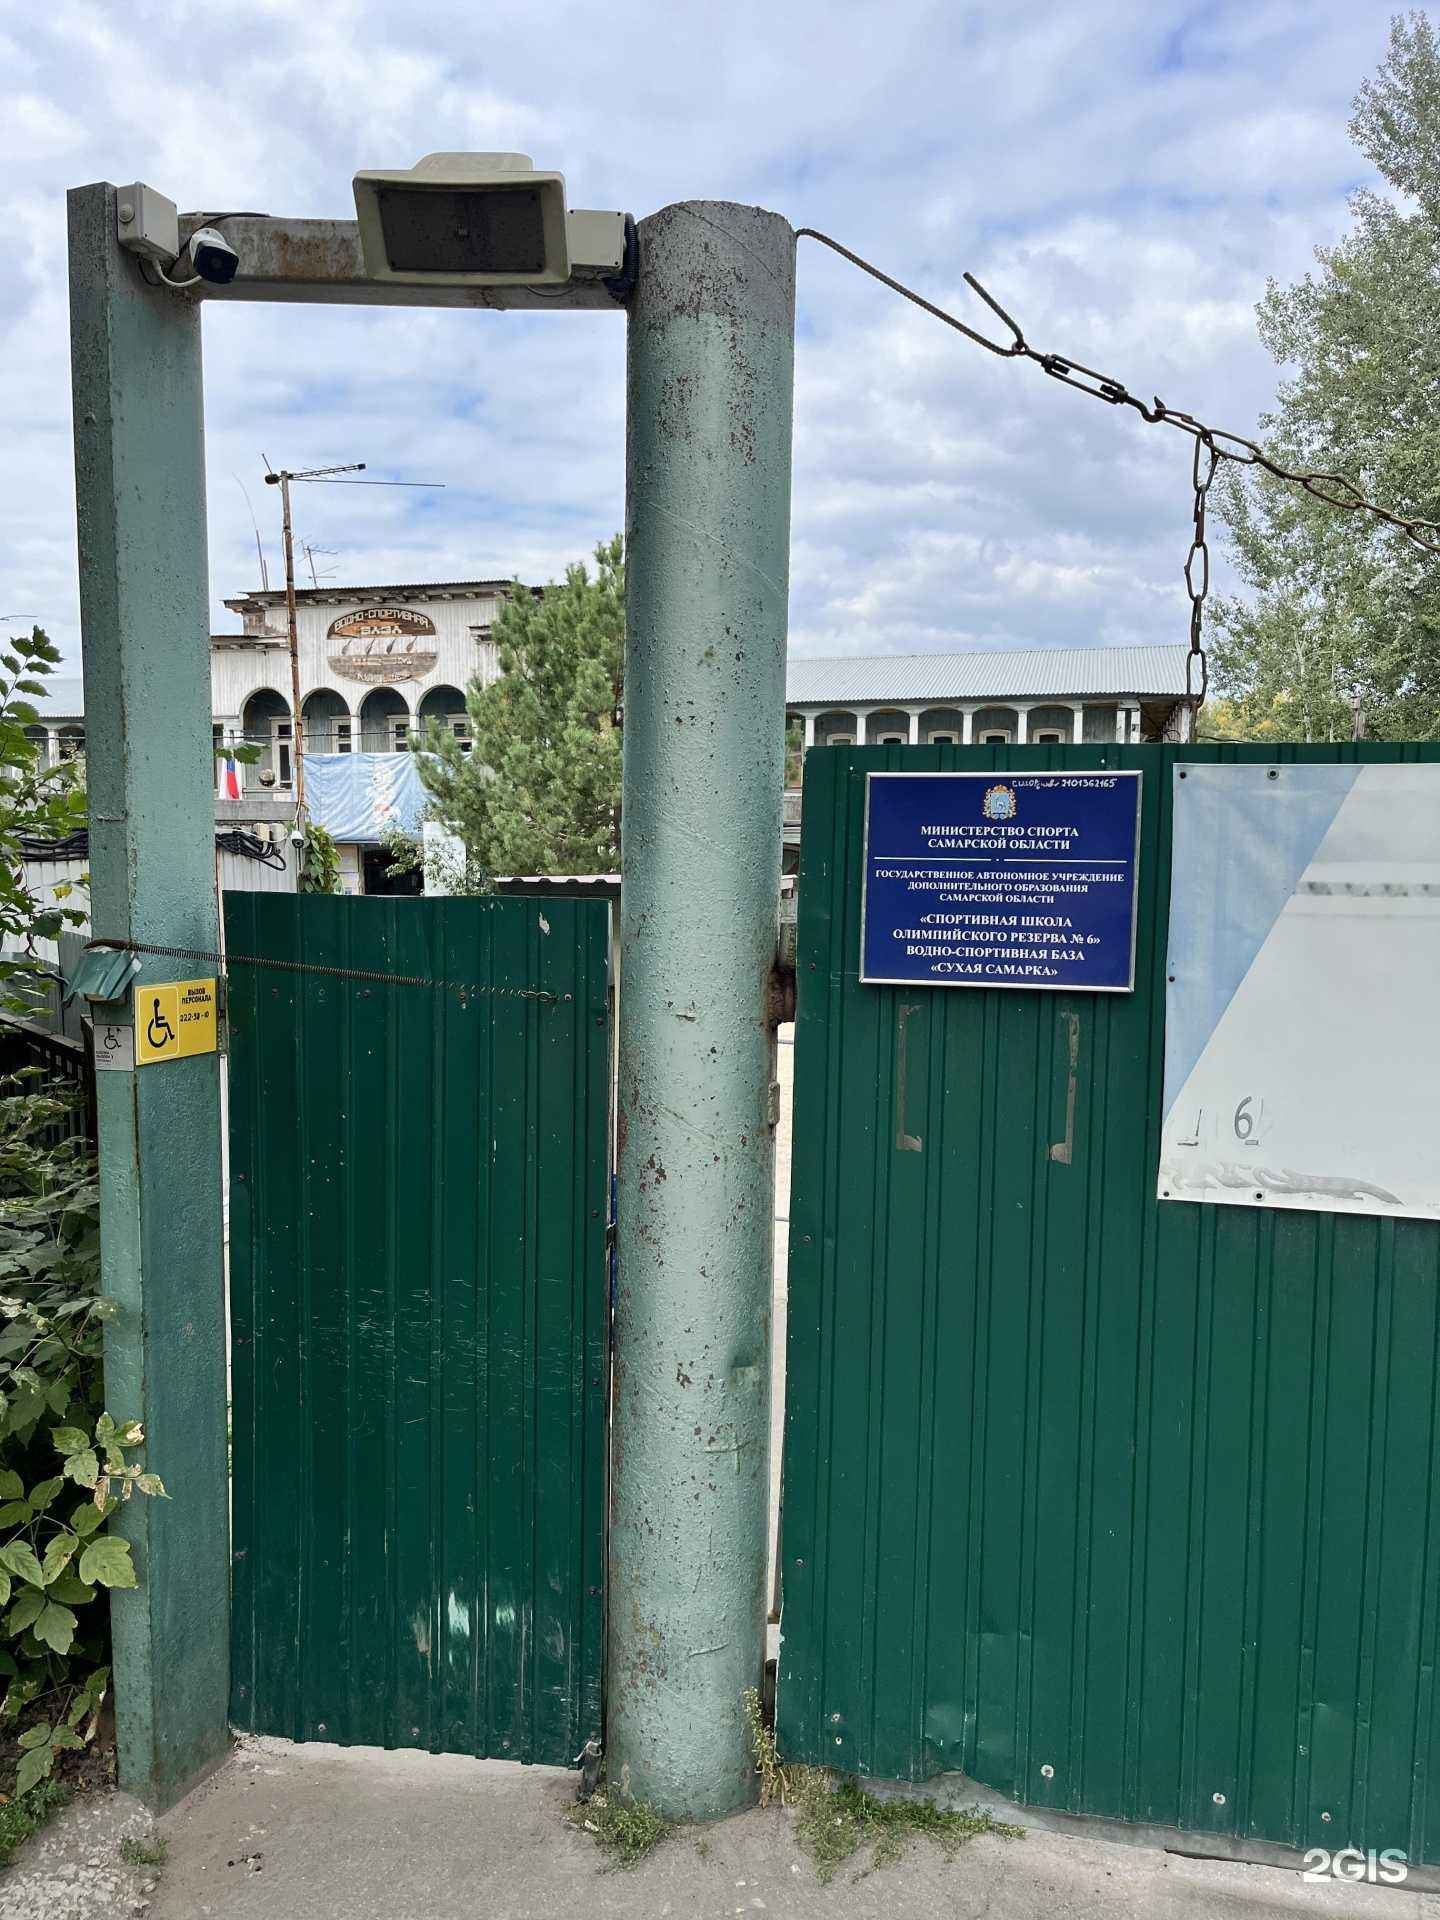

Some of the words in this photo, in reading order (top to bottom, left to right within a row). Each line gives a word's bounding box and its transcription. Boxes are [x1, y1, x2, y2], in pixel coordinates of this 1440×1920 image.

[921, 826, 1024, 837] МИНИСТЕРСТВО
[1028, 827, 1079, 837] СПОРТА
[928, 837, 1006, 849] САМАРСКОЙ
[1010, 839, 1070, 850] ОБЛАСТИ
[876, 870, 974, 880] ГОСУДАРСТВЕННОЕ
[977, 872, 1049, 881] АВТОНОМНОЕ
[1052, 873, 1124, 882] УЧРЕЖДЕНИЕ
[908, 881, 1011, 892] ДОПОЛНИТЕЛЬНОГО
[1014, 883, 1088, 893] ОБРАЗОВАНИЯ
[940, 892, 1003, 902] САМАРСКОЙ
[1006, 894, 1054, 904] ОБЛАСТИ
[920, 914, 1017, 926] «СПОРТИВНАЯ
[1021, 916, 1072, 928] ШКОЛА
[893, 929, 1007, 942] ОЛИМПИЙСКОГО
[1011, 932, 1066, 944] РЕЗЕРВА
[1087, 934, 1101, 945] 6»
[907, 946, 1047, 959] ВОДНО-СПОРТИВНАЯ
[1051, 949, 1085, 961] БАЗА
[930, 963, 982, 974] «СУХАЯ
[985, 965, 1058, 977] САМАРКА»
[188, 987, 206, 995] ВЫЗОВ
[182, 995, 212, 1004] ПЕРСОНАЛА
